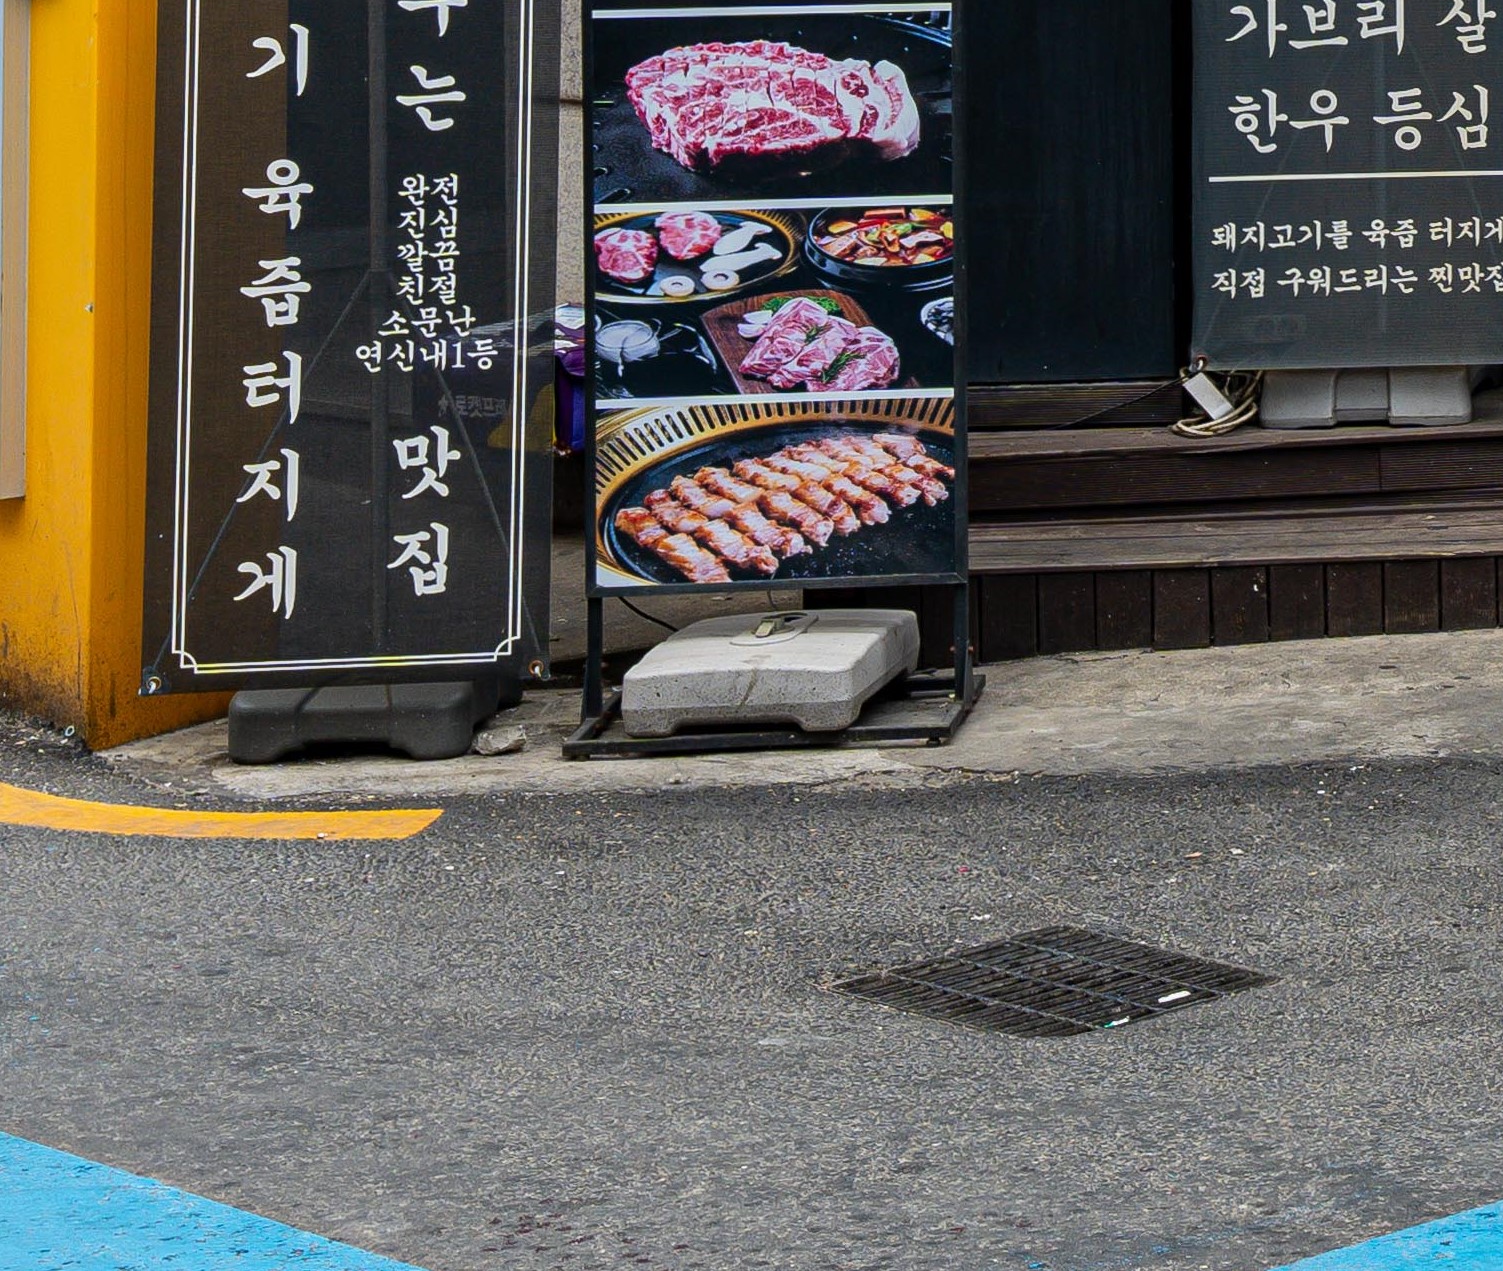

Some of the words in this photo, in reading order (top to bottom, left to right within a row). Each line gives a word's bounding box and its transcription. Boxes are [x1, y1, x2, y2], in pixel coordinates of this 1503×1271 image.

[1228, 88, 1349, 153] 한우
[1373, 84, 1489, 151] 등심
[1211, 220, 1353, 253] 돼지고기를
[1361, 218, 1418, 248] 육즙
[1211, 268, 1264, 299] 직접
[1276, 265, 1418, 298] 구워드리는
[378, 305, 477, 338] 소문난
[355, 341, 499, 371] 연신내1등
[387, 425, 461, 598] 맛집
